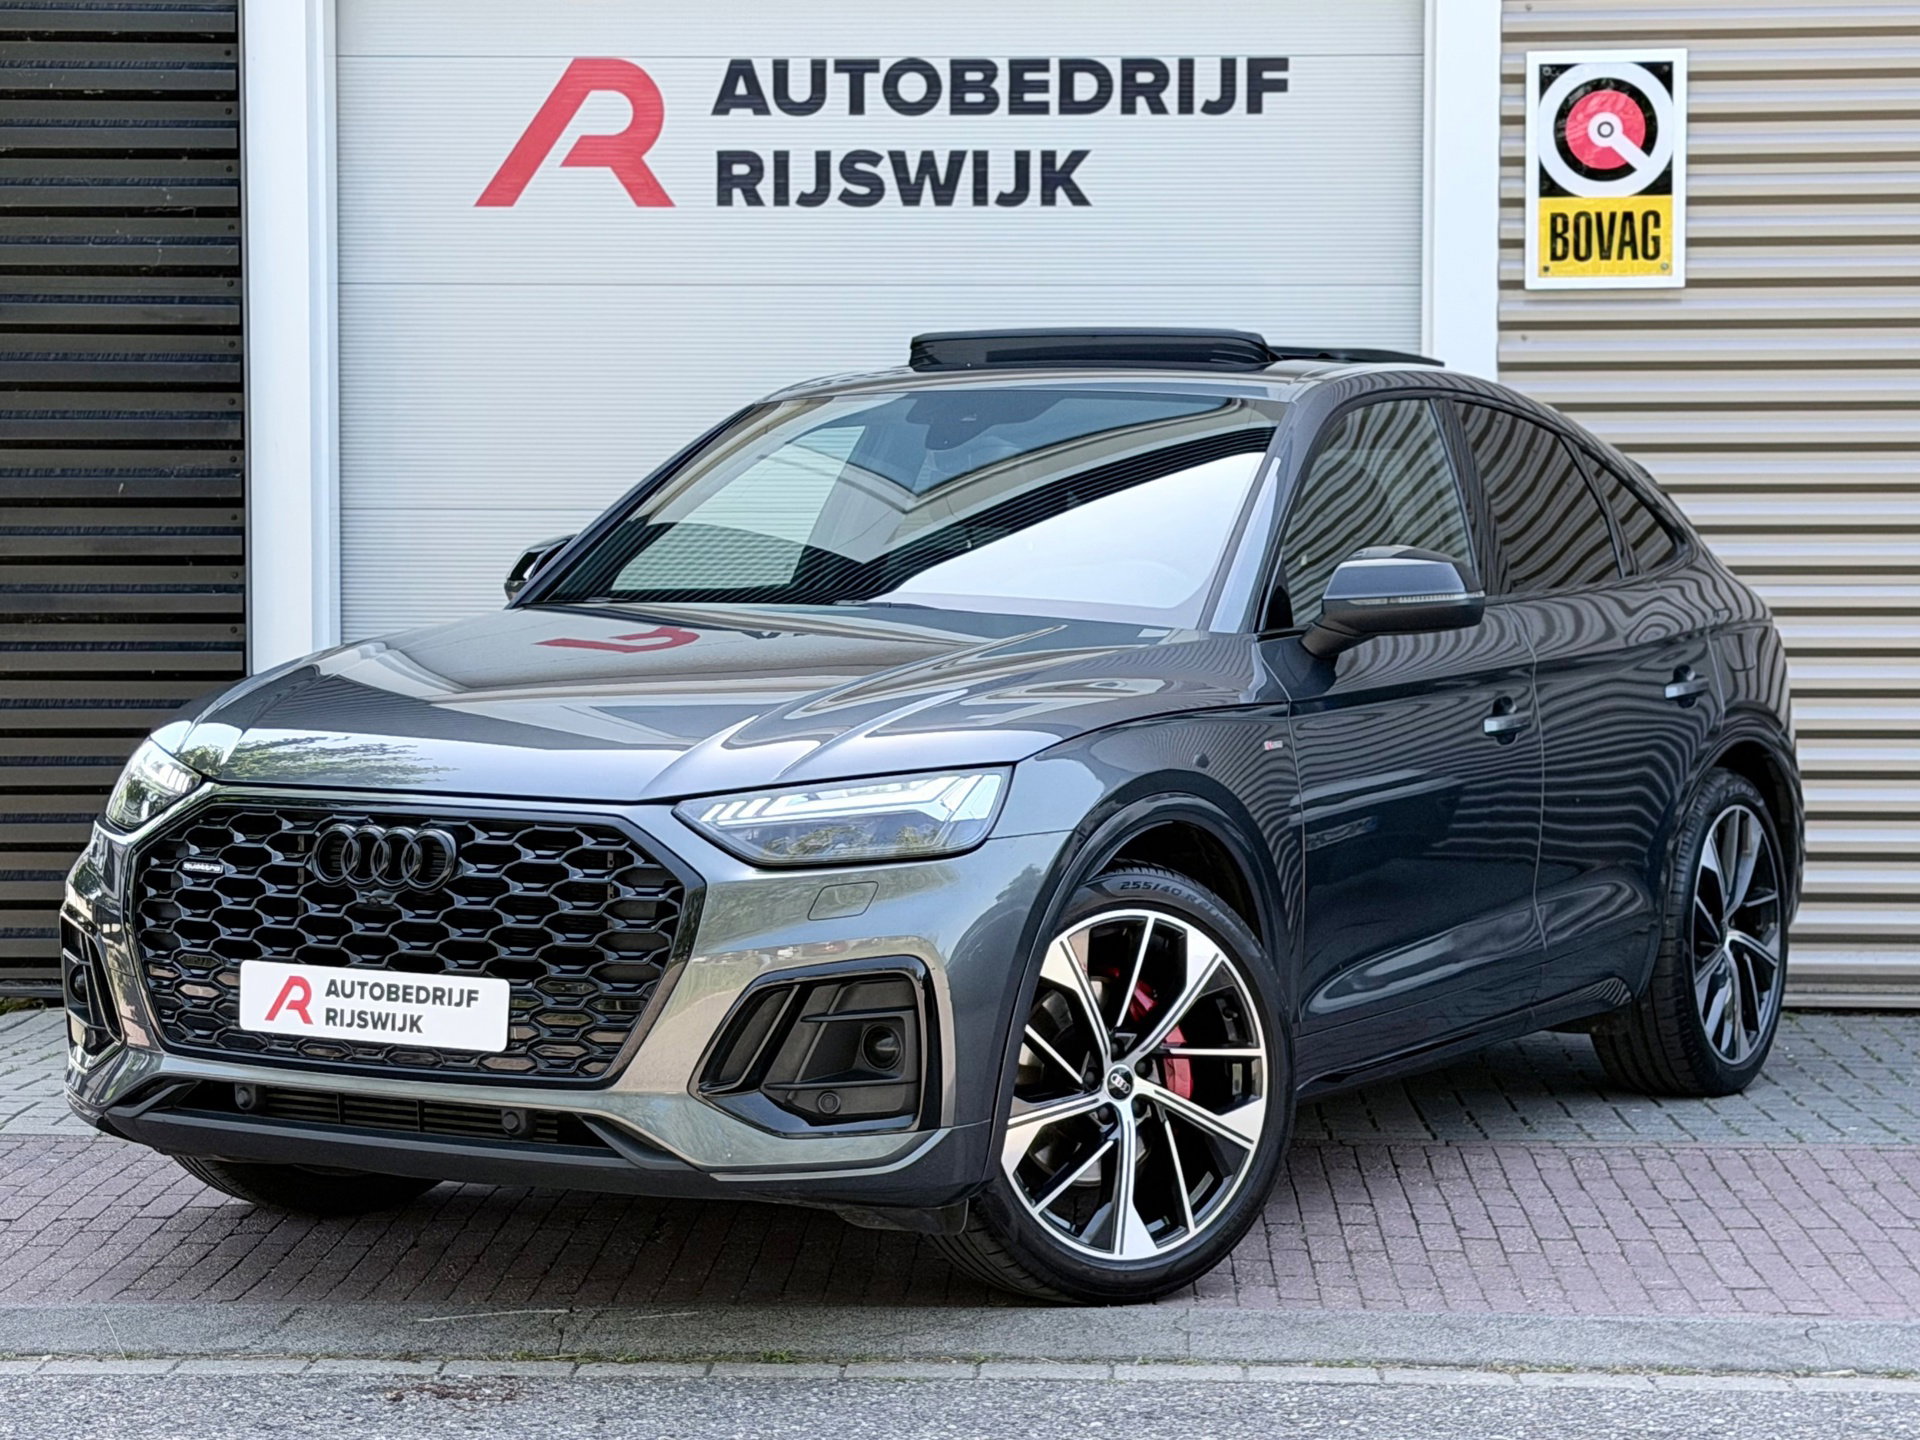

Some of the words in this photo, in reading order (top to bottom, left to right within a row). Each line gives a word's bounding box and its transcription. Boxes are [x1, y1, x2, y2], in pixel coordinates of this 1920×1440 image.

[711, 58, 1289, 117] AUTOBEDRIJF
[716, 149, 1091, 208] RIJSWIJK
[1550, 209, 1661, 262] BOVAG
[183, 862, 222, 872] quattro
[1120, 881, 1182, 896] 255/40
[325, 978, 479, 1008] AUTOBEDRIJF
[325, 1007, 423, 1034] RIJSWIJK
